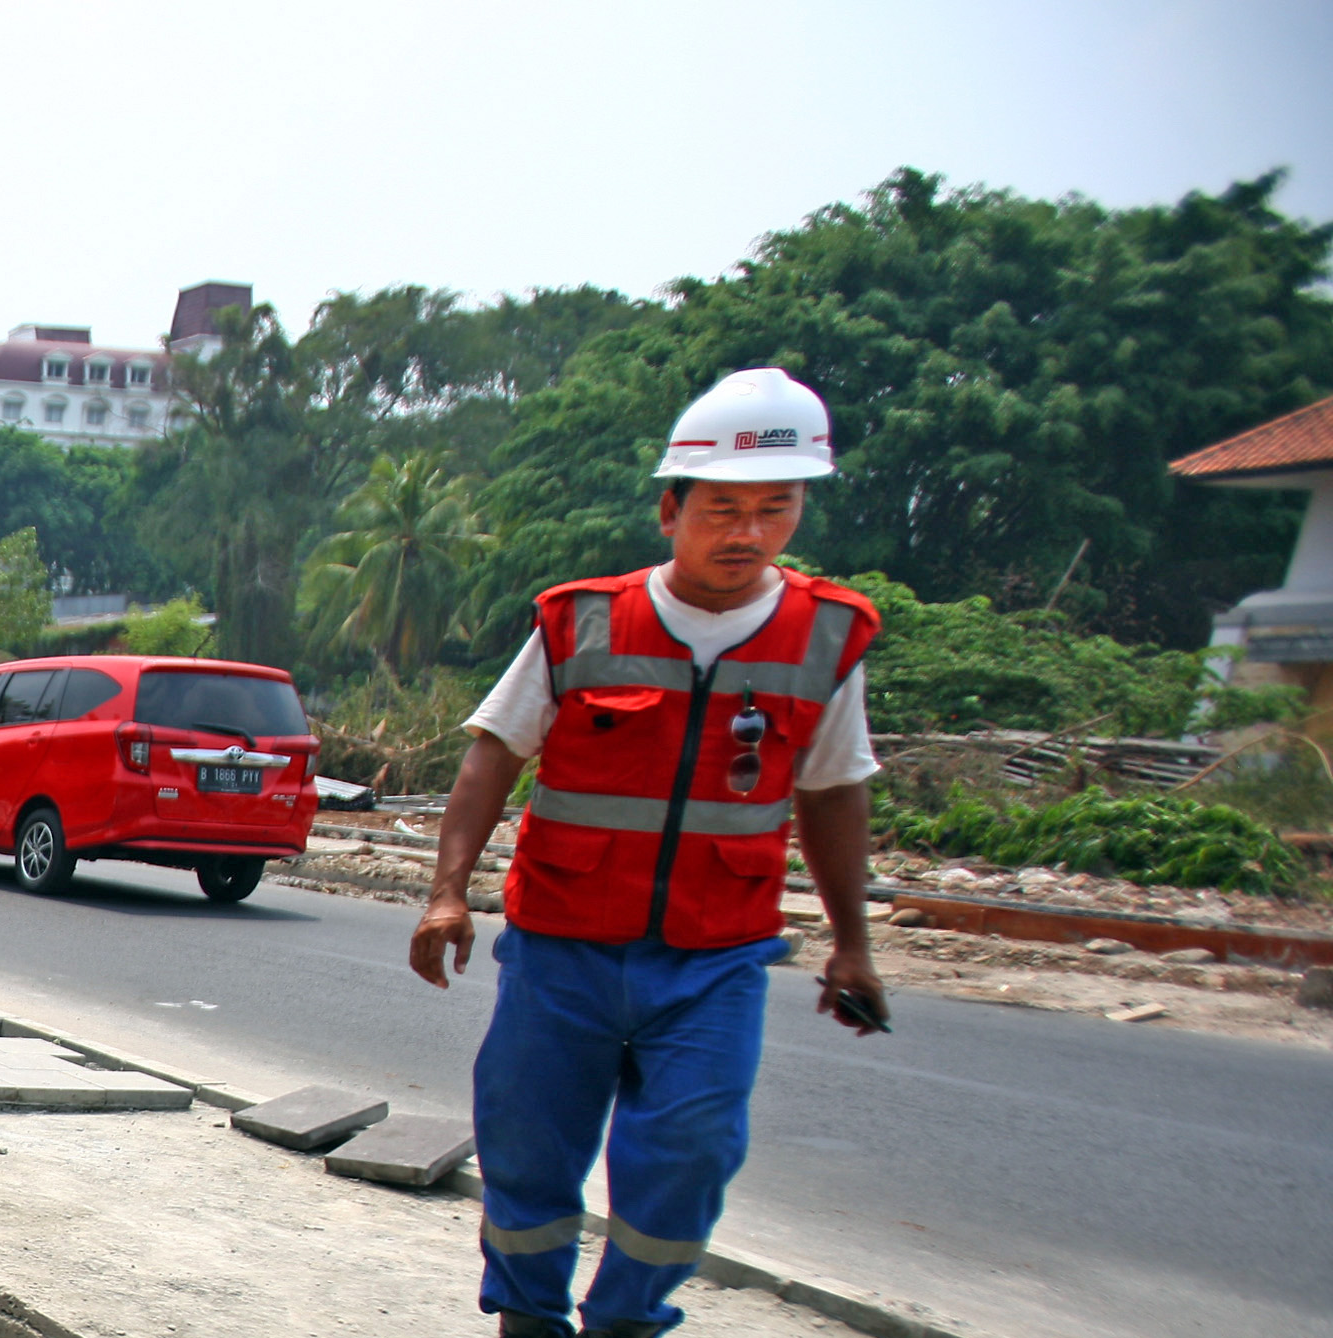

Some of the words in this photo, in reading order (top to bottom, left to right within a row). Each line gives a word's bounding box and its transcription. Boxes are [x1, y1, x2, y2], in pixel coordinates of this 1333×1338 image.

[757, 428, 798, 439] JAYA
[200, 767, 207, 780] B
[242, 770, 260, 783] PYY
